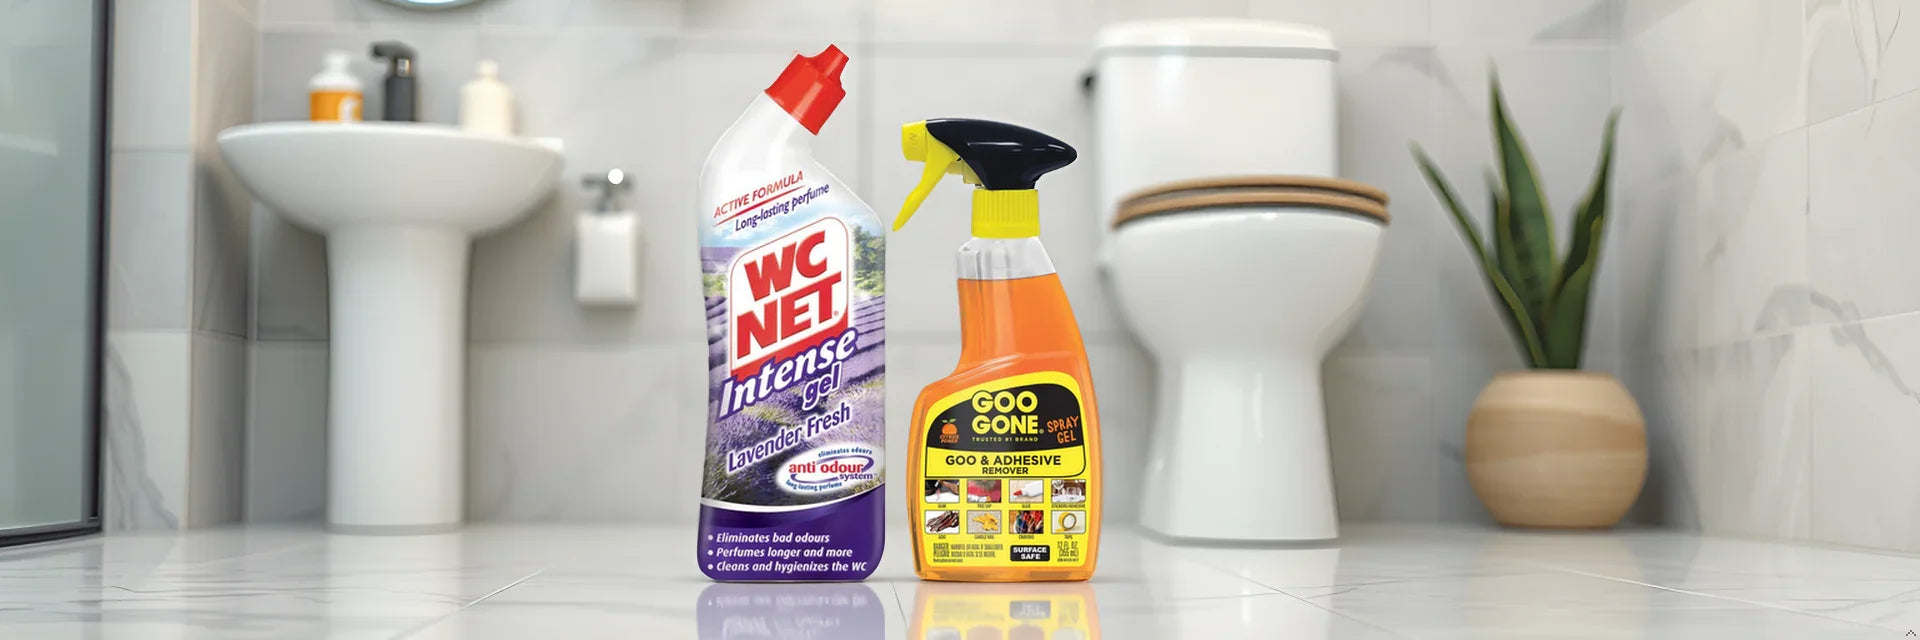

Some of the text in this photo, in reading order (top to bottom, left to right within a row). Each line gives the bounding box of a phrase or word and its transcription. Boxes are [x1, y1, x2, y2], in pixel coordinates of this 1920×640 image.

[714, 171, 803, 218] ACTIVE FORMULA
[735, 184, 829, 231] Long-lasting perfume
[744, 230, 827, 302] WC
[737, 271, 841, 360] NET
[716, 327, 859, 421] Intense
[802, 361, 842, 410] gel
[972, 391, 1038, 413] GOO
[972, 415, 1038, 434] GONE
[1046, 416, 1078, 433] SPRAY
[728, 401, 850, 472] Lavender Fresh
[1057, 430, 1077, 444] GEL
[818, 449, 849, 457] eliminates
[945, 455, 1062, 466] GOO & ADHESIVE
[788, 460, 864, 473] anti odour
[839, 473, 873, 481] system
[819, 482, 842, 491] perfume
[716, 532, 831, 543] Eliminates bad odours
[716, 546, 853, 559] Perfumes longer and more
[716, 561, 868, 574] Cleans and hygienizes the WC
